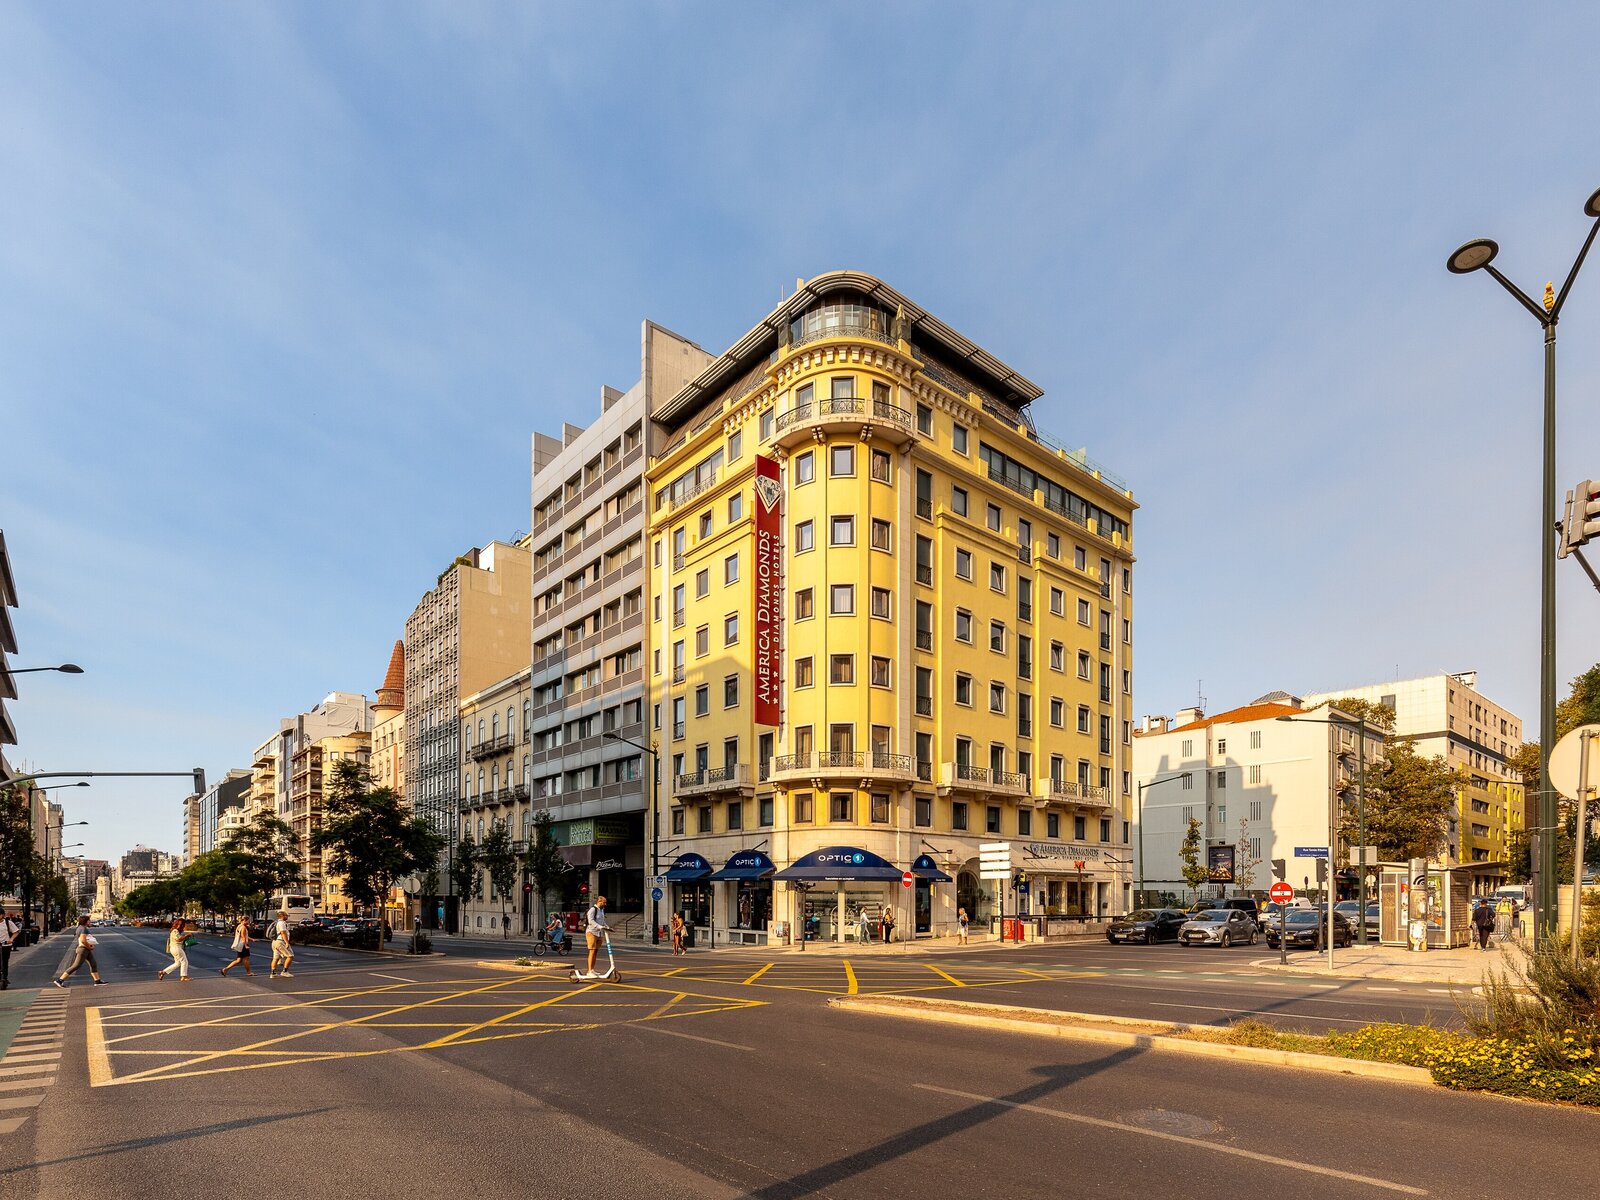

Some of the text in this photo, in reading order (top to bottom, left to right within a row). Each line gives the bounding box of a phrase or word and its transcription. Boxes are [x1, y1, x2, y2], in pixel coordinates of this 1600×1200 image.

[757, 529, 770, 705] AMERICA DIAMONDS
[774, 649, 780, 660] BY
[1040, 844, 1099, 857] AMERICA DIAMONDS
